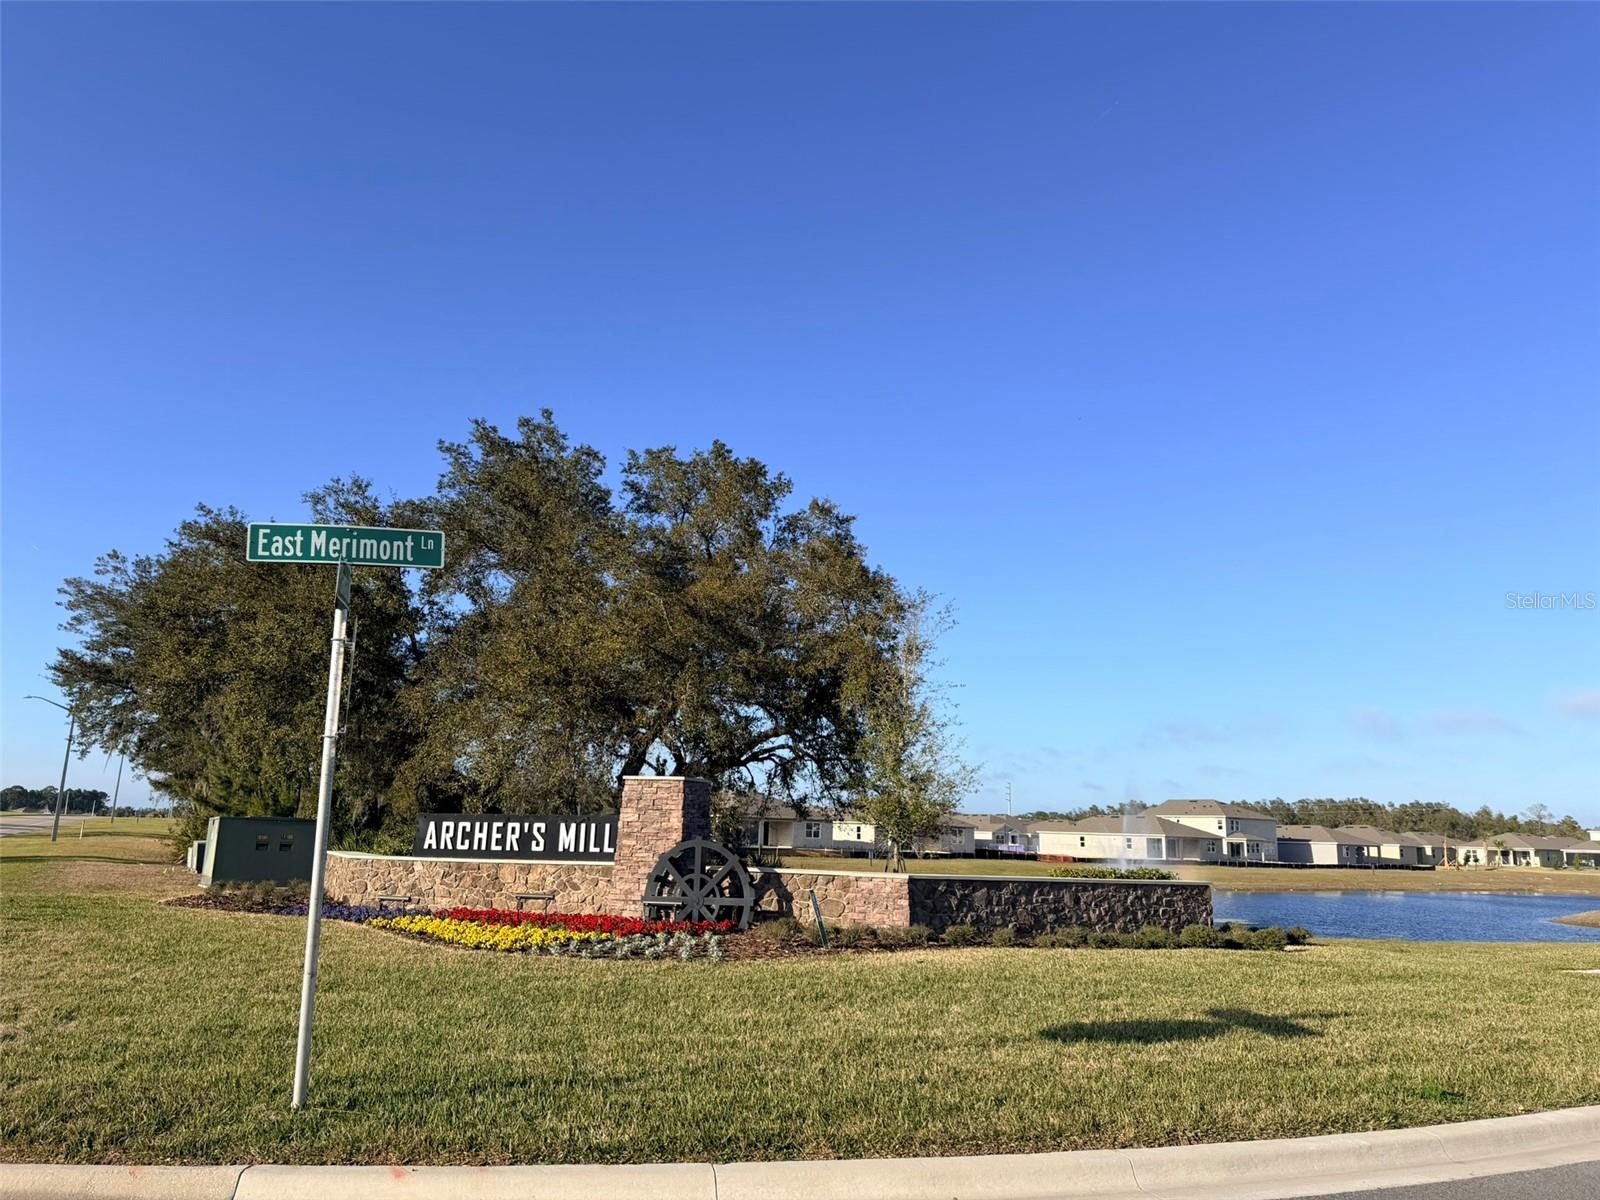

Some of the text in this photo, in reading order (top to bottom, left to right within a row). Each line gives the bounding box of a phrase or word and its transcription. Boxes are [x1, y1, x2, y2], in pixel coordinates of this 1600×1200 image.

[257, 528, 434, 561] East Merimont Ln
[423, 821, 615, 853] ARCHER'S MILL
